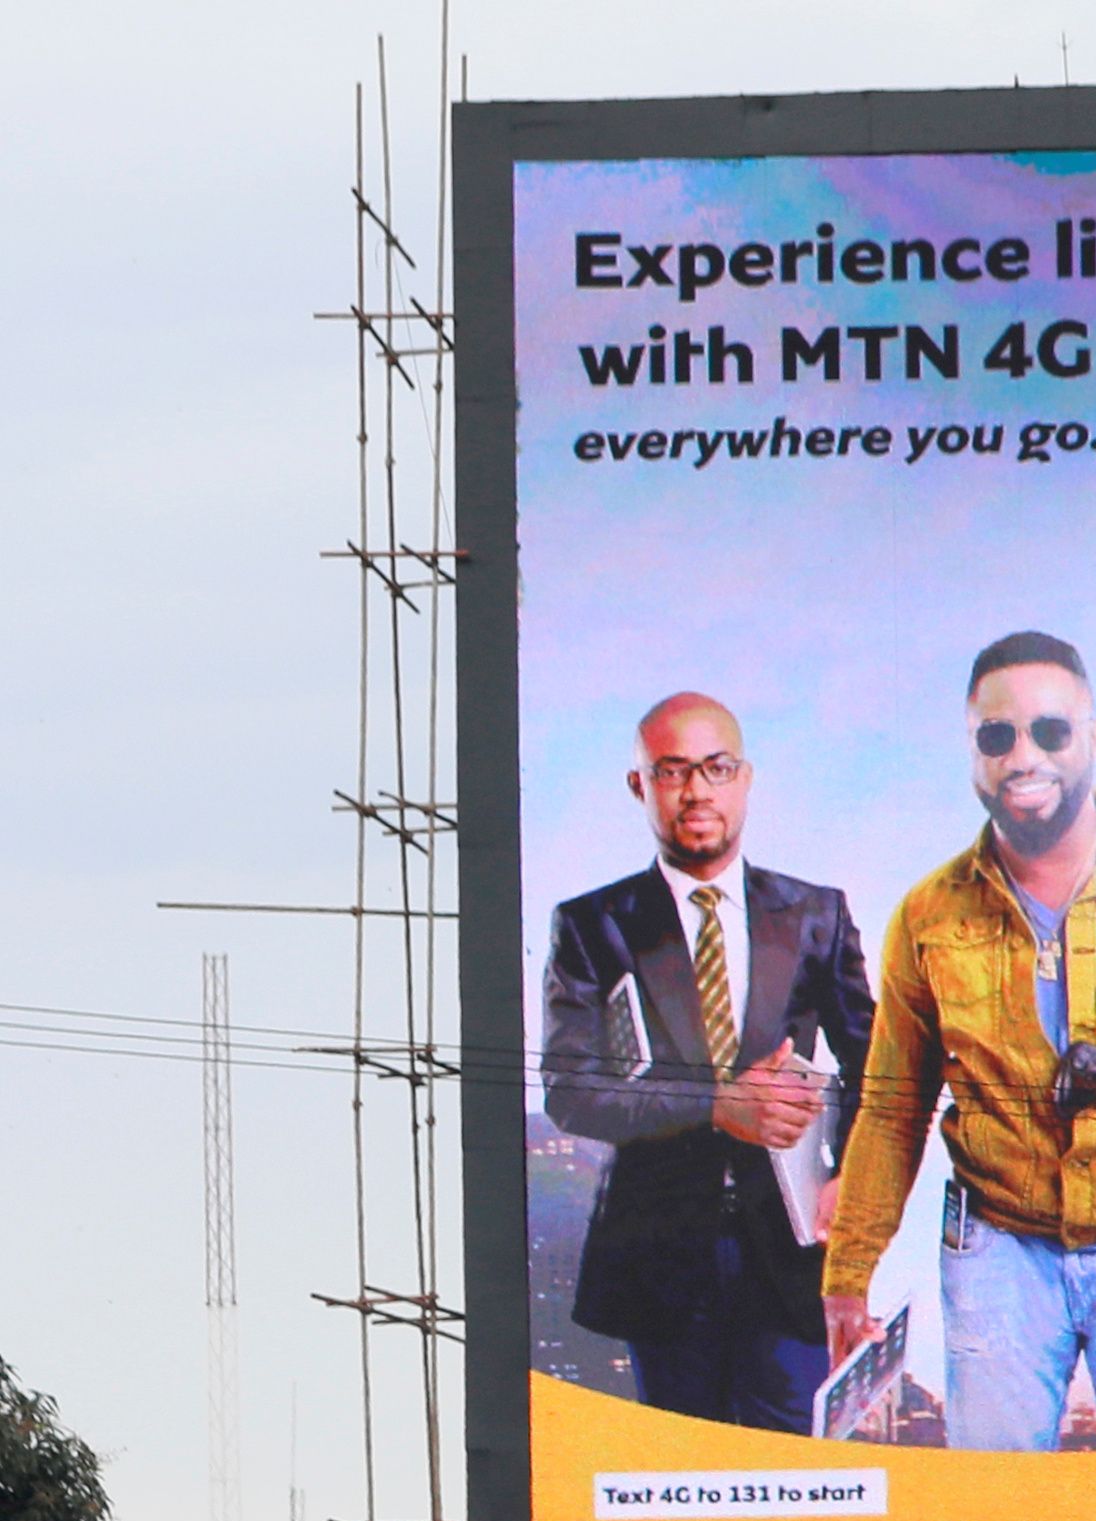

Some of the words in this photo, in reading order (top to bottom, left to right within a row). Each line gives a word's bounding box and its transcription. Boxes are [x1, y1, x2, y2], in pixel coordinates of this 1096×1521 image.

[574, 222, 1030, 302] Experience
[578, 323, 754, 386] with
[781, 325, 960, 381] MTN
[983, 319, 1092, 378] 4G
[573, 416, 893, 470] everywhere
[904, 422, 1005, 465] you
[603, 1487, 653, 1504] Text
[698, 1486, 722, 1503] to
[728, 1485, 770, 1502] 131
[778, 1485, 803, 1502] to
[808, 1484, 867, 1502] start
